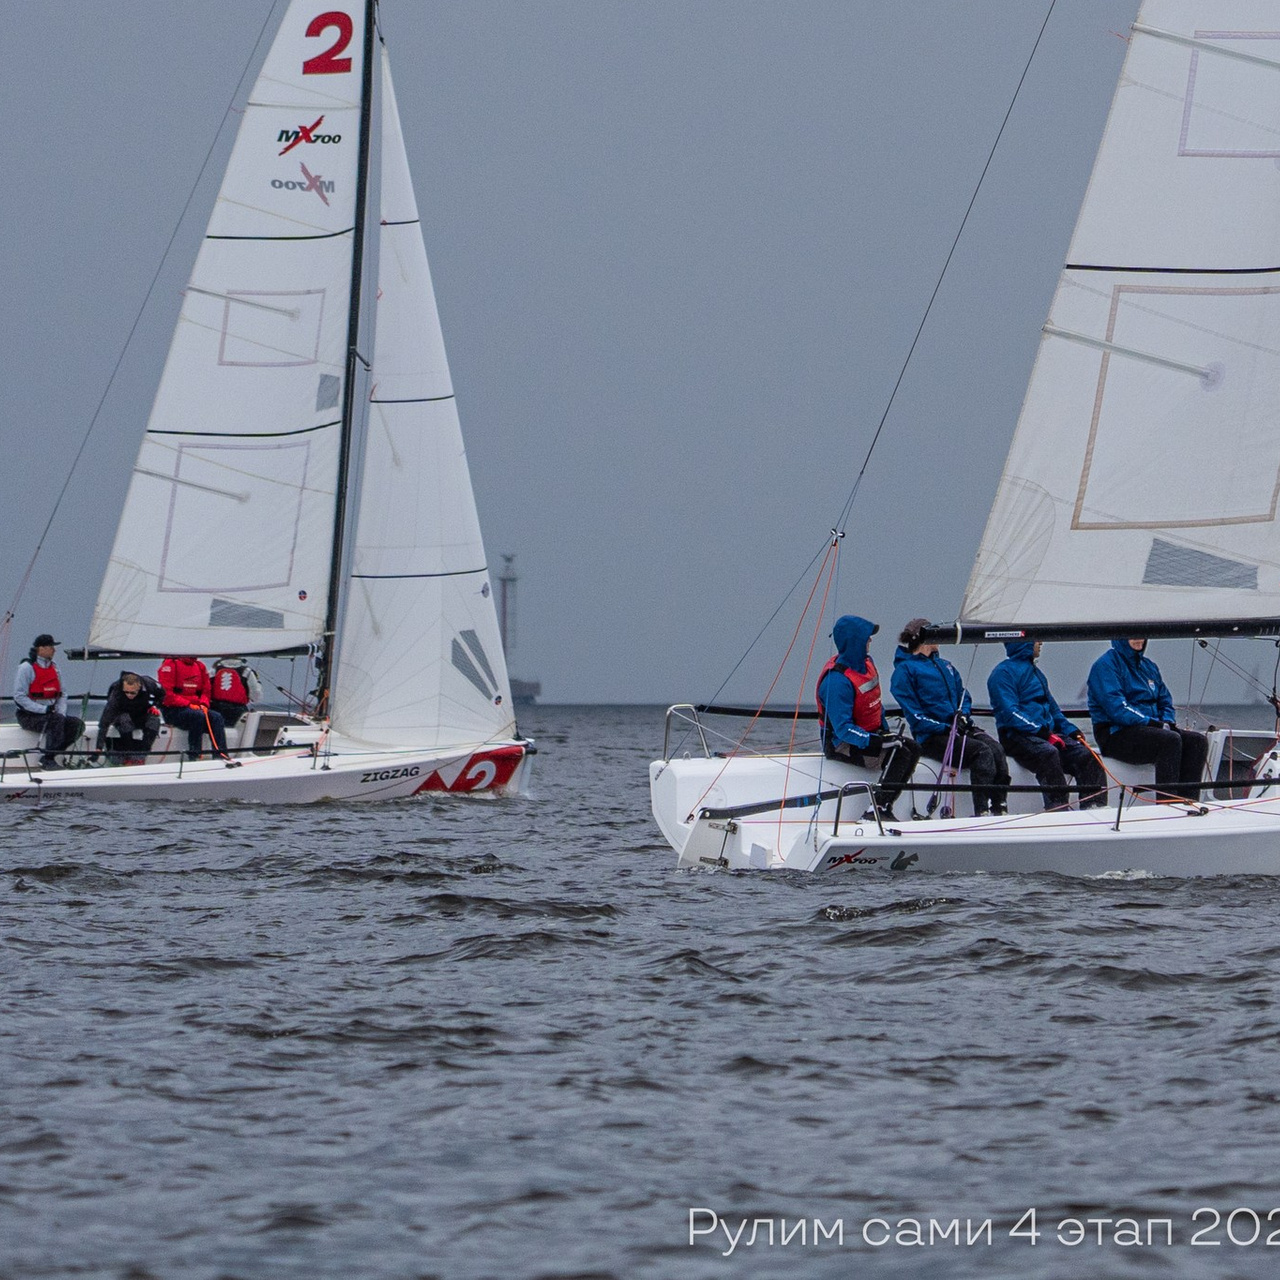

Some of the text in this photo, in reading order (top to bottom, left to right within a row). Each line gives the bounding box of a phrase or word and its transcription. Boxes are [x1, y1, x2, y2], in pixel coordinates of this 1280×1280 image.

[302, 11, 353, 75] 2
[276, 115, 342, 156] MX700
[360, 766, 420, 783] ZIGZAG
